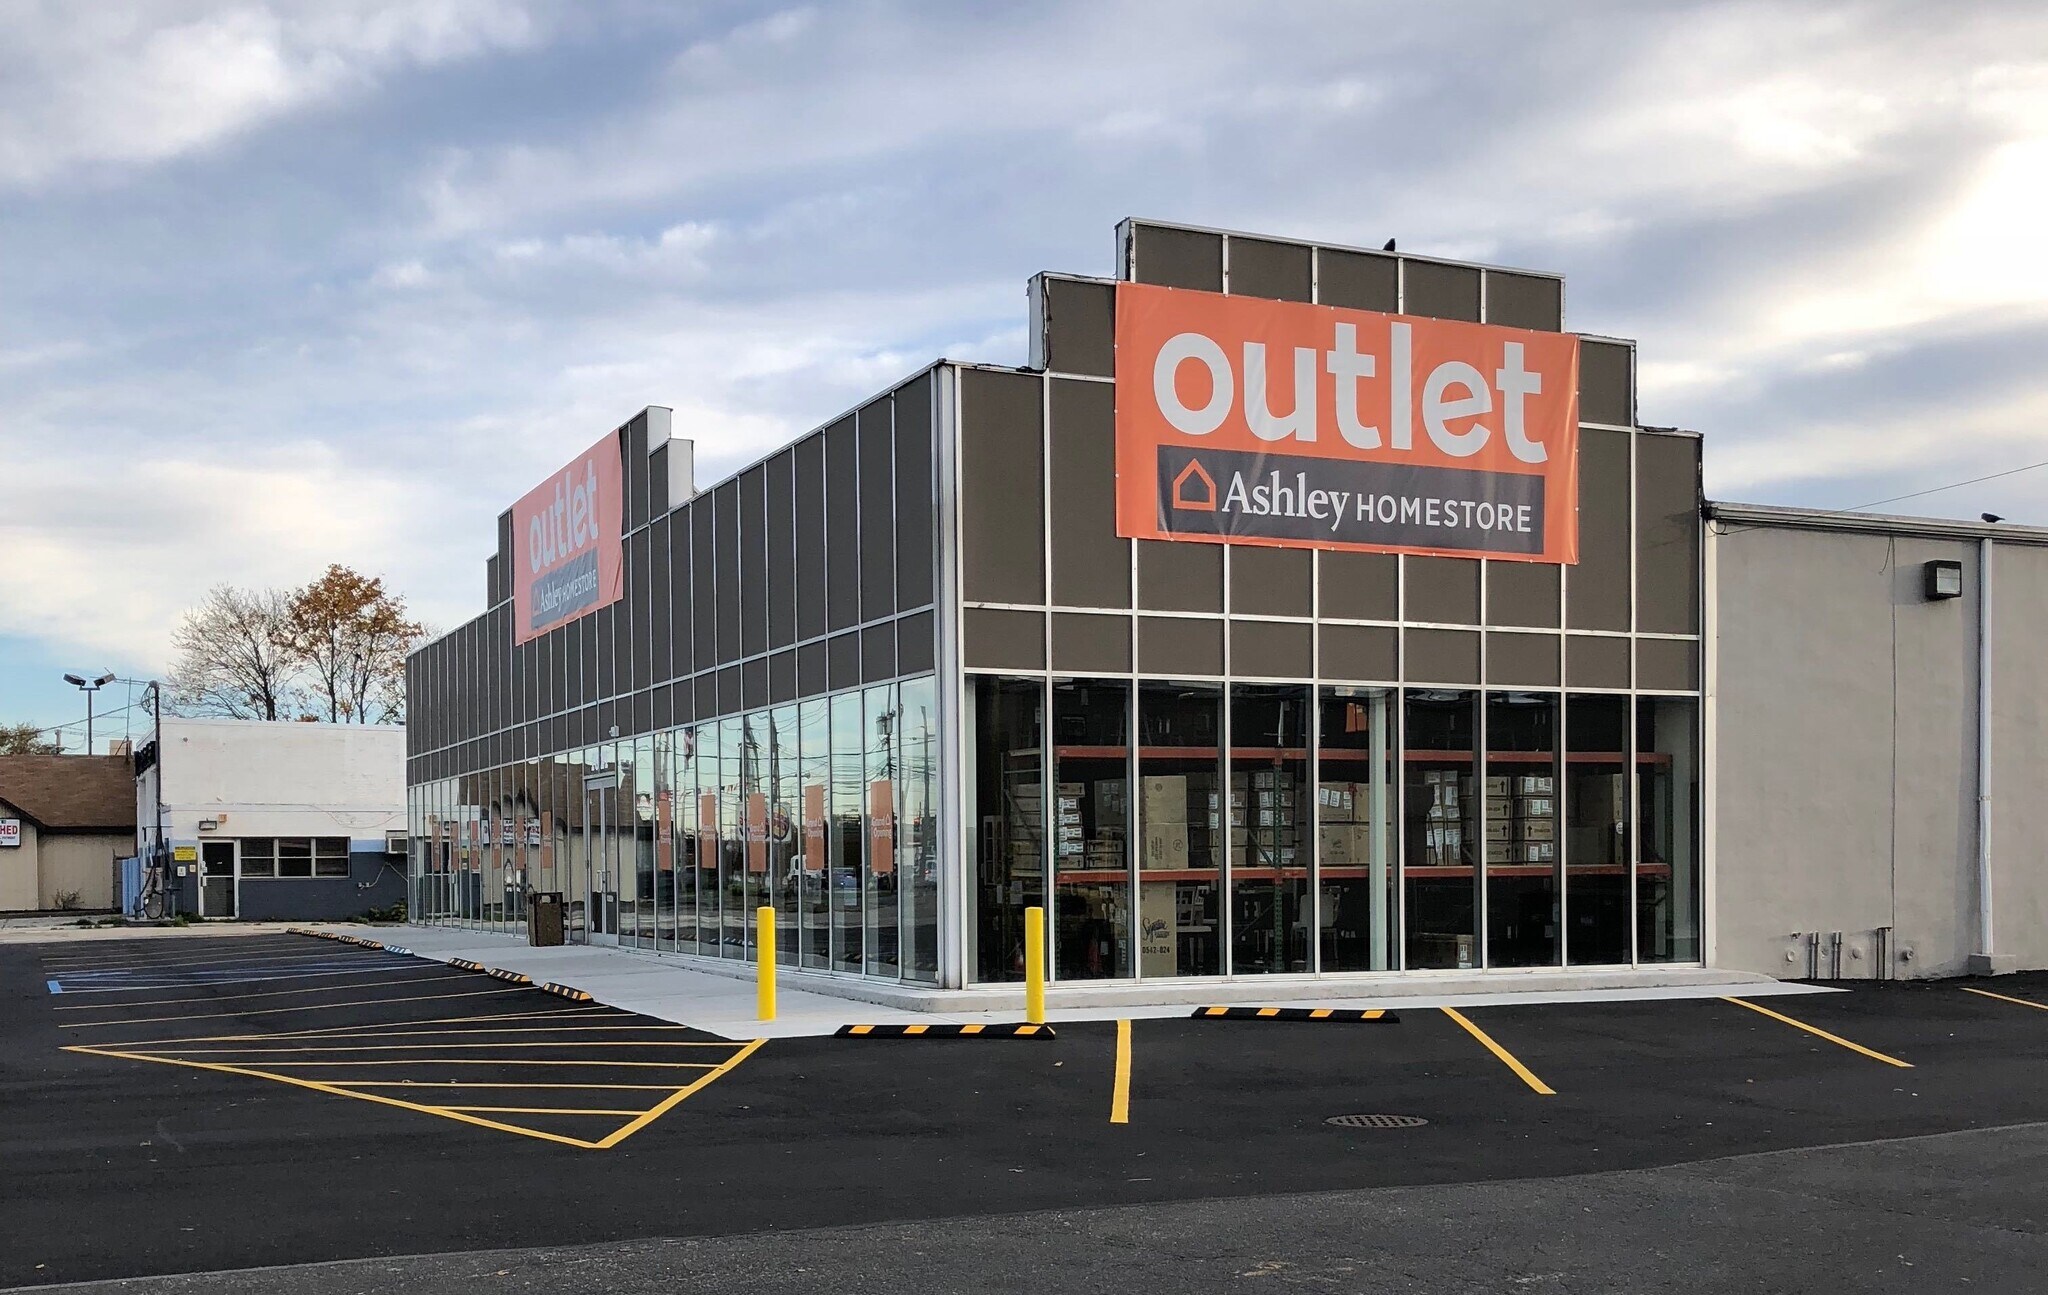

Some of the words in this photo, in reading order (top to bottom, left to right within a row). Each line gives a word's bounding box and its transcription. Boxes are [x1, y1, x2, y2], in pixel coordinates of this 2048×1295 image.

[1153, 321, 1548, 464] outlet
[529, 459, 599, 574] outlet
[1221, 470, 1350, 532] Ashley
[1356, 493, 1532, 533] HOMESTORE
[539, 584, 563, 612] Ashley
[562, 568, 597, 603] HOMESTORE
